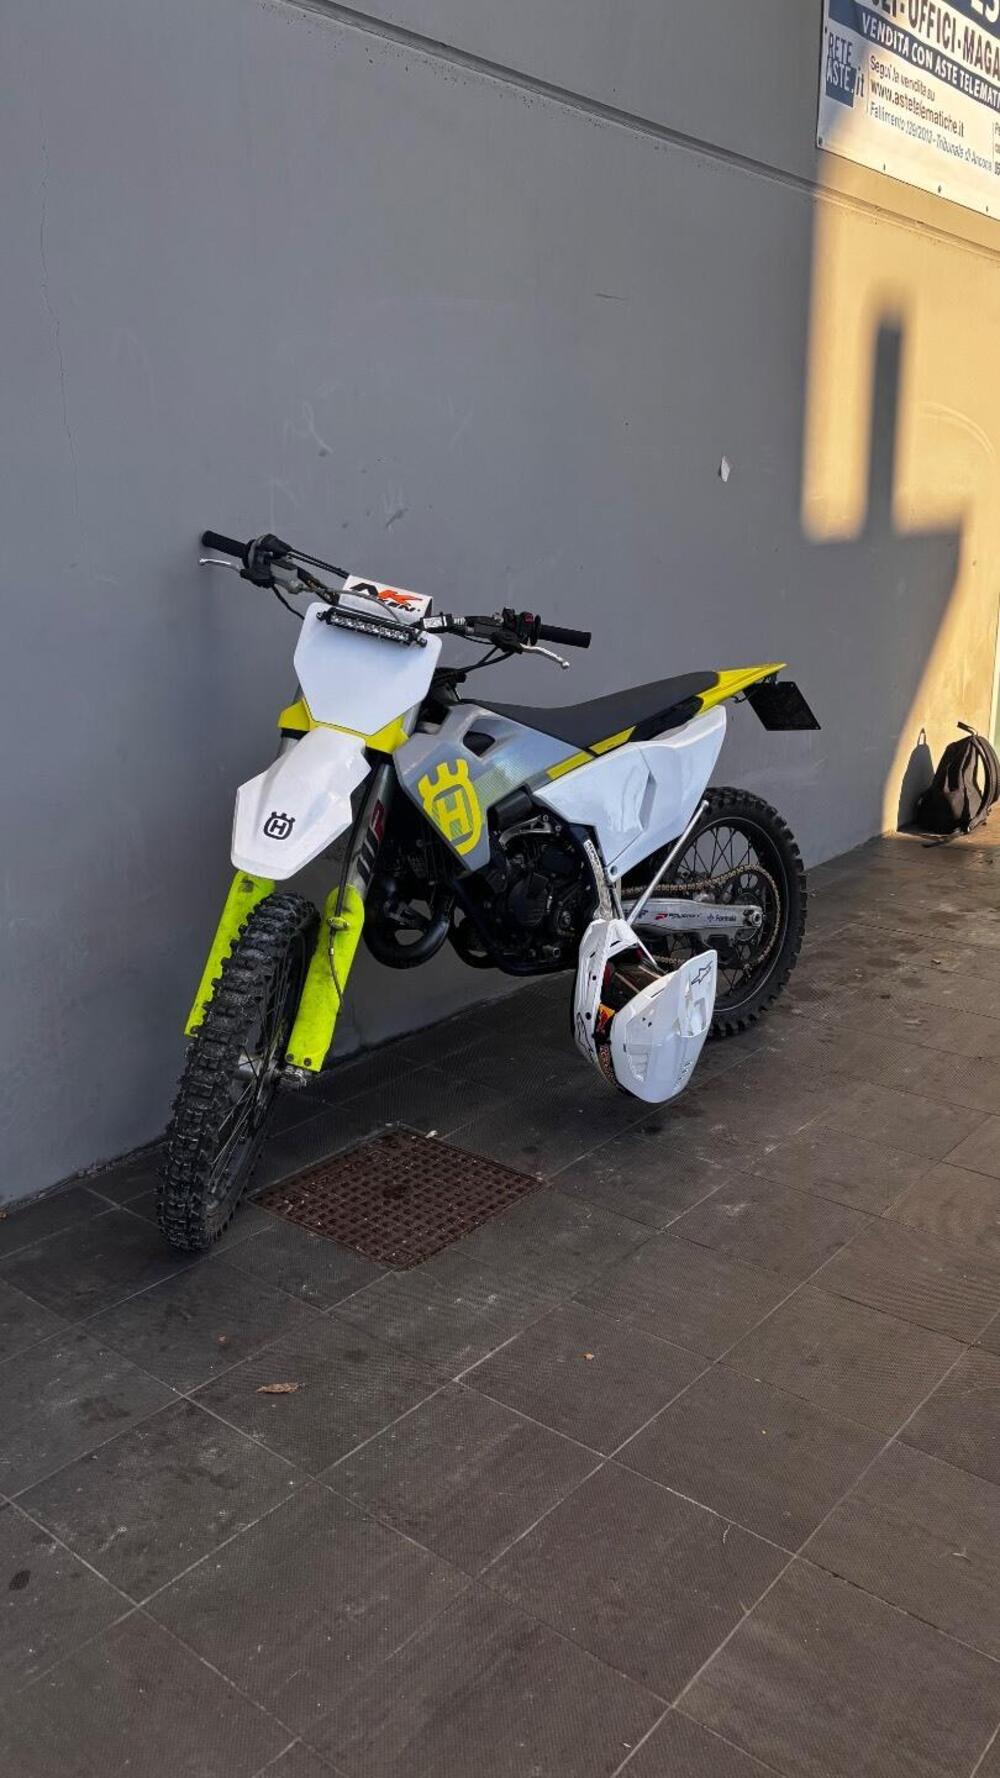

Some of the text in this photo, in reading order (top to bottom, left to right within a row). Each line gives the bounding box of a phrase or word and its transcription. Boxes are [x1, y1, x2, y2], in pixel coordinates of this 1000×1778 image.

[828, 32, 853, 65] RETE
[862, 12, 909, 57] VENDITA
[911, 42, 933, 70] CON
[935, 55, 958, 84] ASTE
[908, 0, 956, 53] UFFICI
[870, 55, 892, 80] Segui
[900, 75, 926, 97] vendita
[871, 79, 964, 137] www.astetelematiche.it
